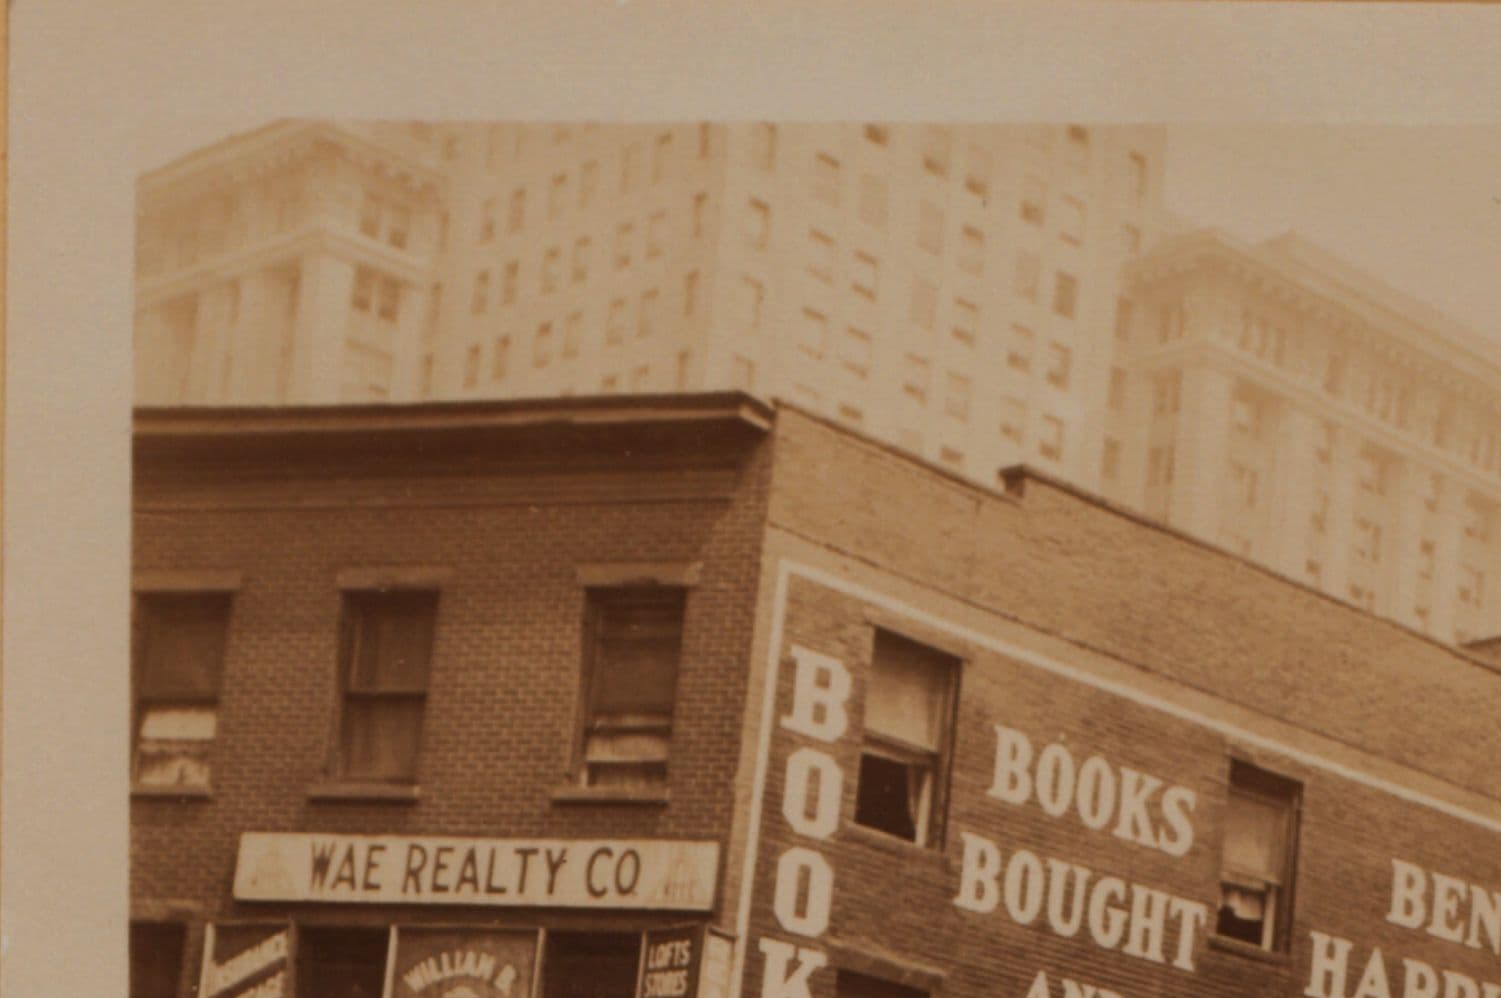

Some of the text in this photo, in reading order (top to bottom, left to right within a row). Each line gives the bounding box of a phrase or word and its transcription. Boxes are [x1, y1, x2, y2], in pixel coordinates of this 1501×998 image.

[986, 724, 1197, 857] BOOKS
[309, 841, 387, 891] WAE
[401, 843, 567, 896] REALTY
[584, 846, 642, 898] CO
[953, 831, 1208, 972] BOUGHT
[402, 950, 496, 992] WILLIAM
[647, 939, 691, 971] LOFTS
